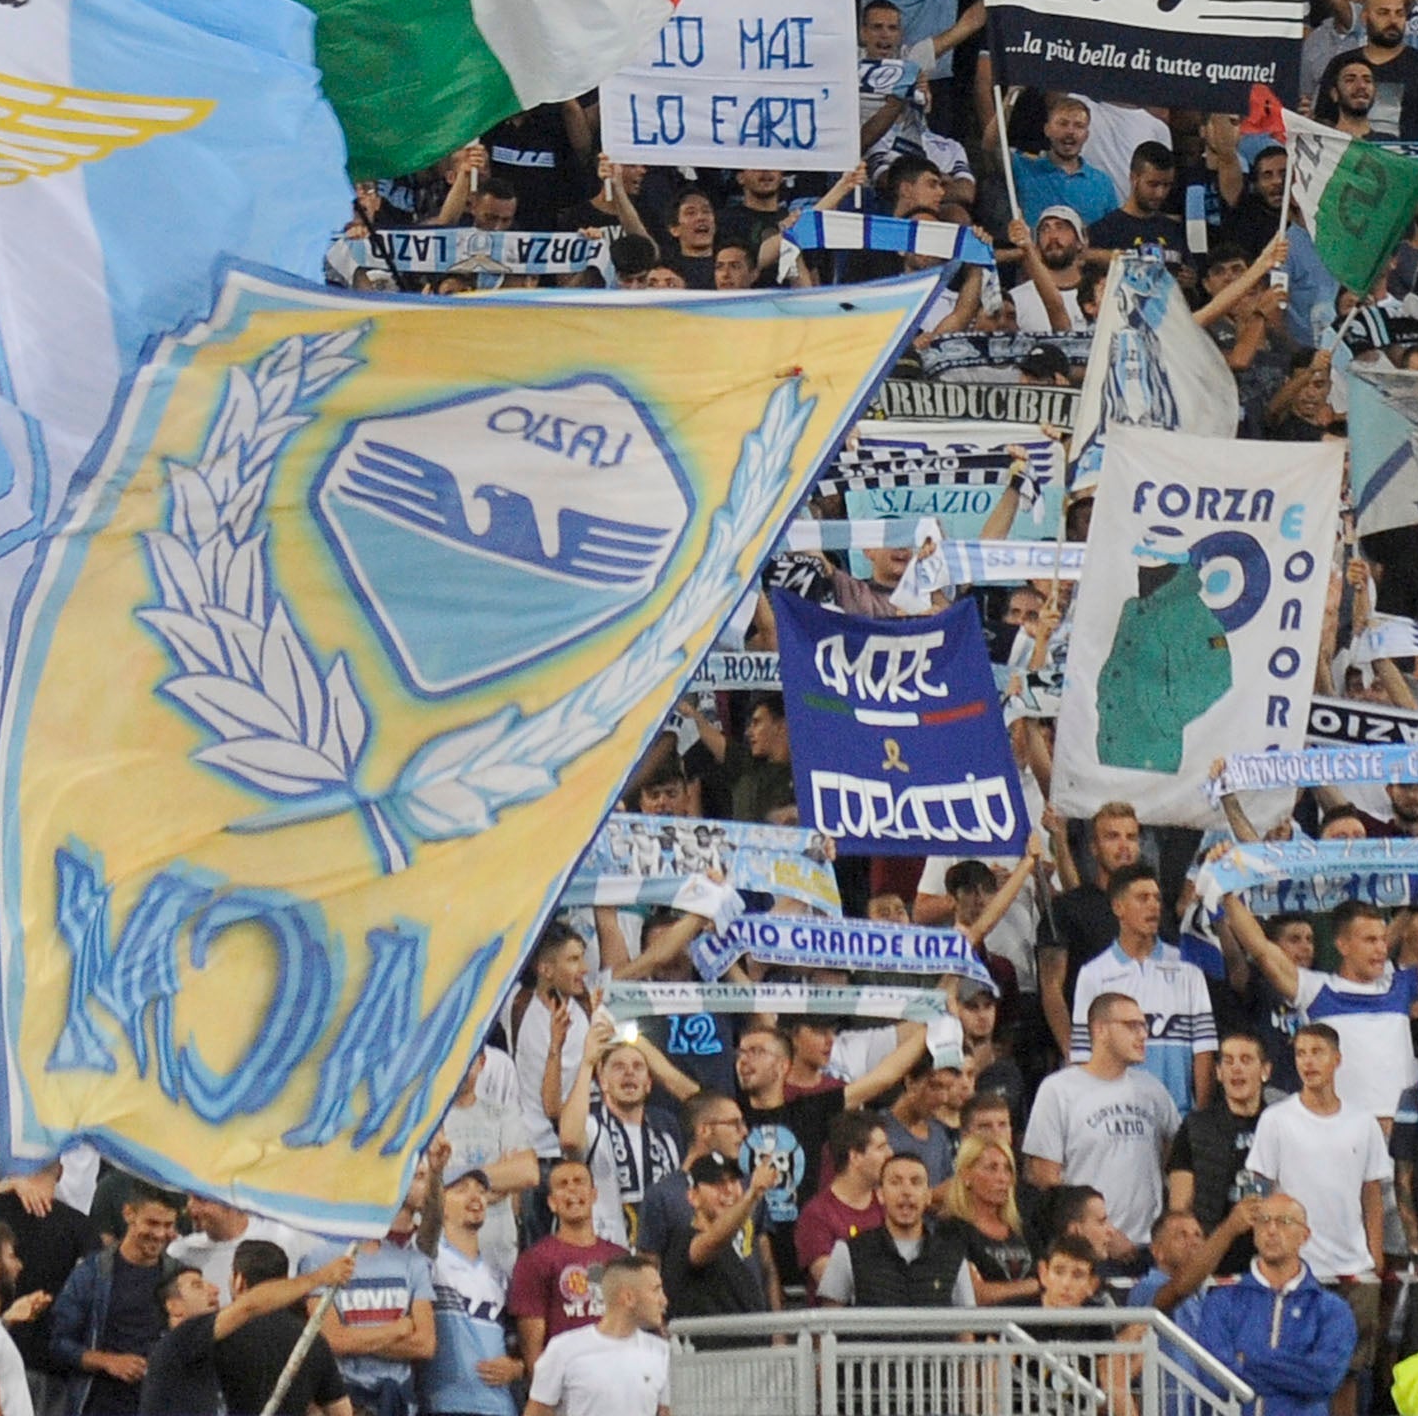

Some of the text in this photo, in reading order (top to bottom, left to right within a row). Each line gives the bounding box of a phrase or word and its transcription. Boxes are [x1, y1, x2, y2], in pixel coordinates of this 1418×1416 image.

[738, 17, 815, 70] MAI
[1004, 31, 1277, 83] ...la più bella di tutte quante!
[630, 93, 684, 146] LO
[516, 236, 604, 263] FORZA
[890, 458, 960, 474] LAZIO
[903, 490, 992, 515] LAZIO
[1131, 480, 1276, 522] FORZA
[814, 630, 949, 703] AMORE
[1229, 752, 1384, 786] BIANCOCELESTE
[789, 927, 904, 957] GRANDE
[1105, 1119, 1145, 1137] LAZIO
